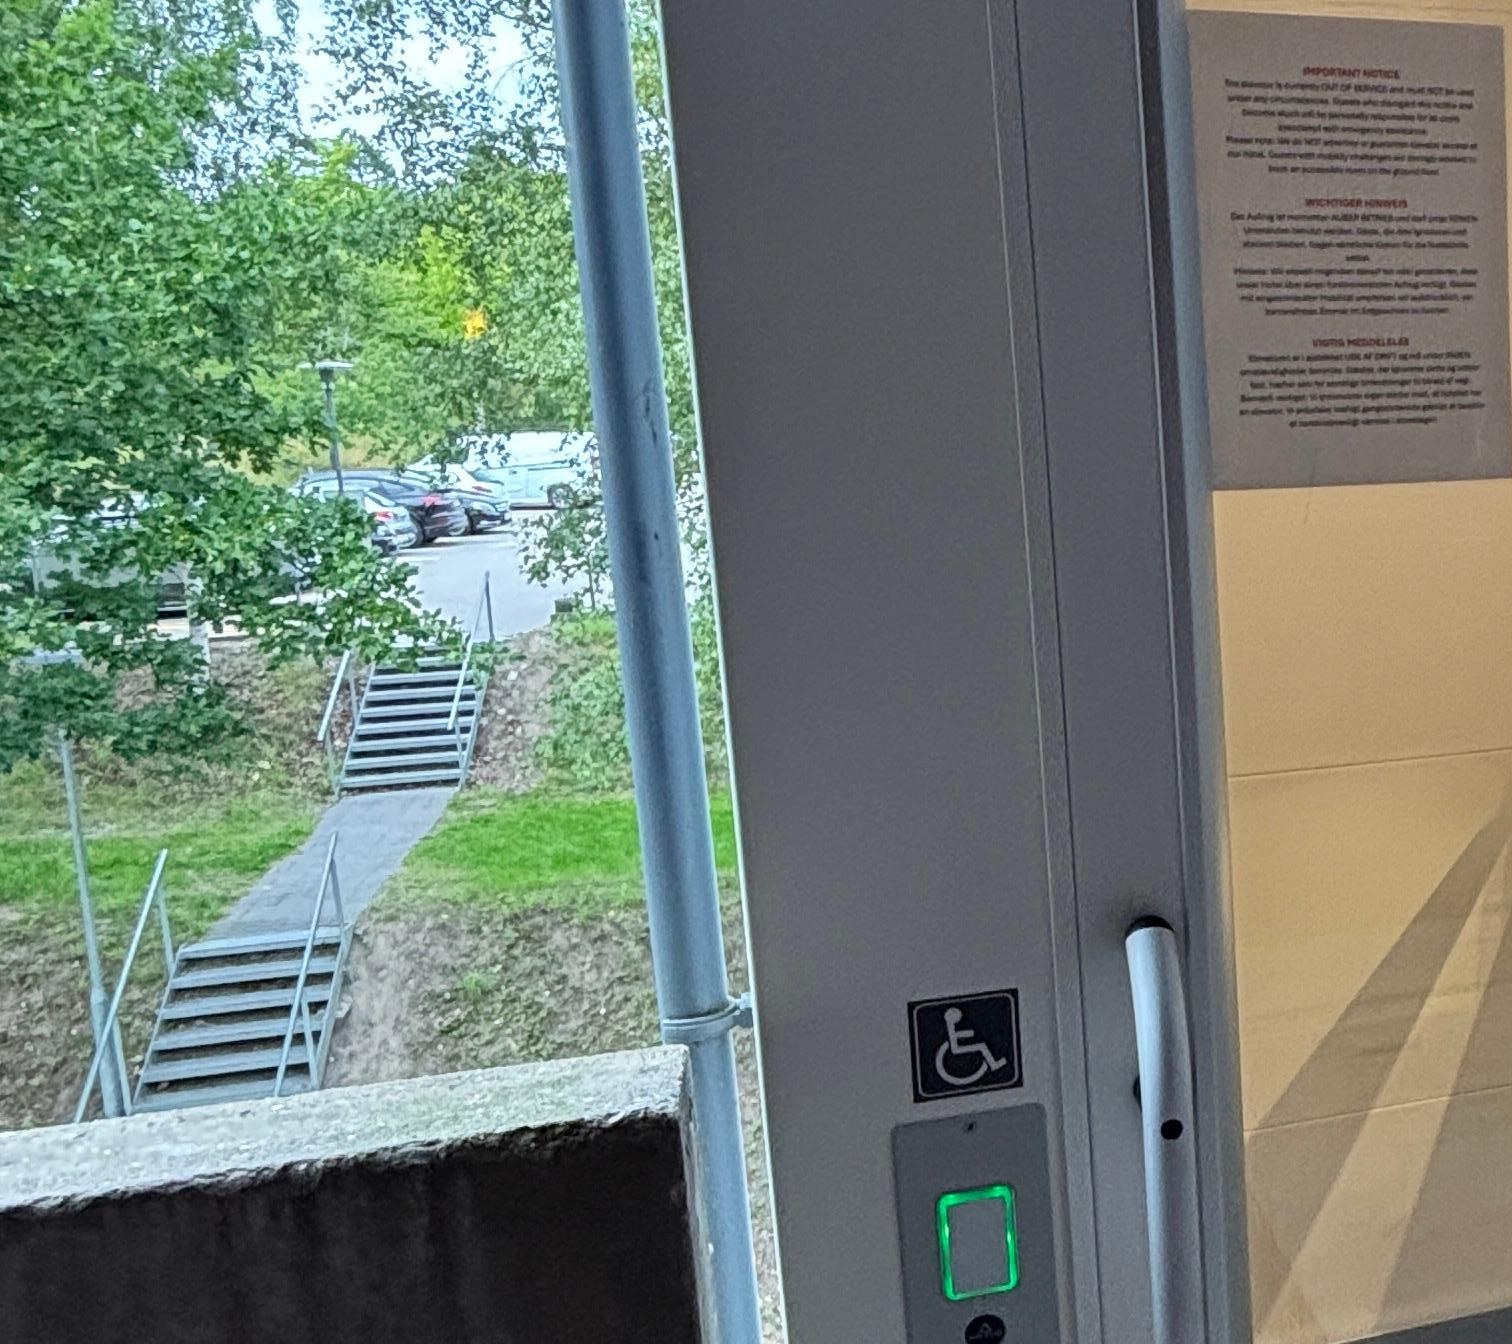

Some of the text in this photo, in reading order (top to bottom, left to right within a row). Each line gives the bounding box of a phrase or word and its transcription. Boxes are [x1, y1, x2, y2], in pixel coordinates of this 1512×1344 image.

[1303, 67, 1399, 79] IMPORTANT NOTICE
[1305, 199, 1362, 207] WICHTIGER
